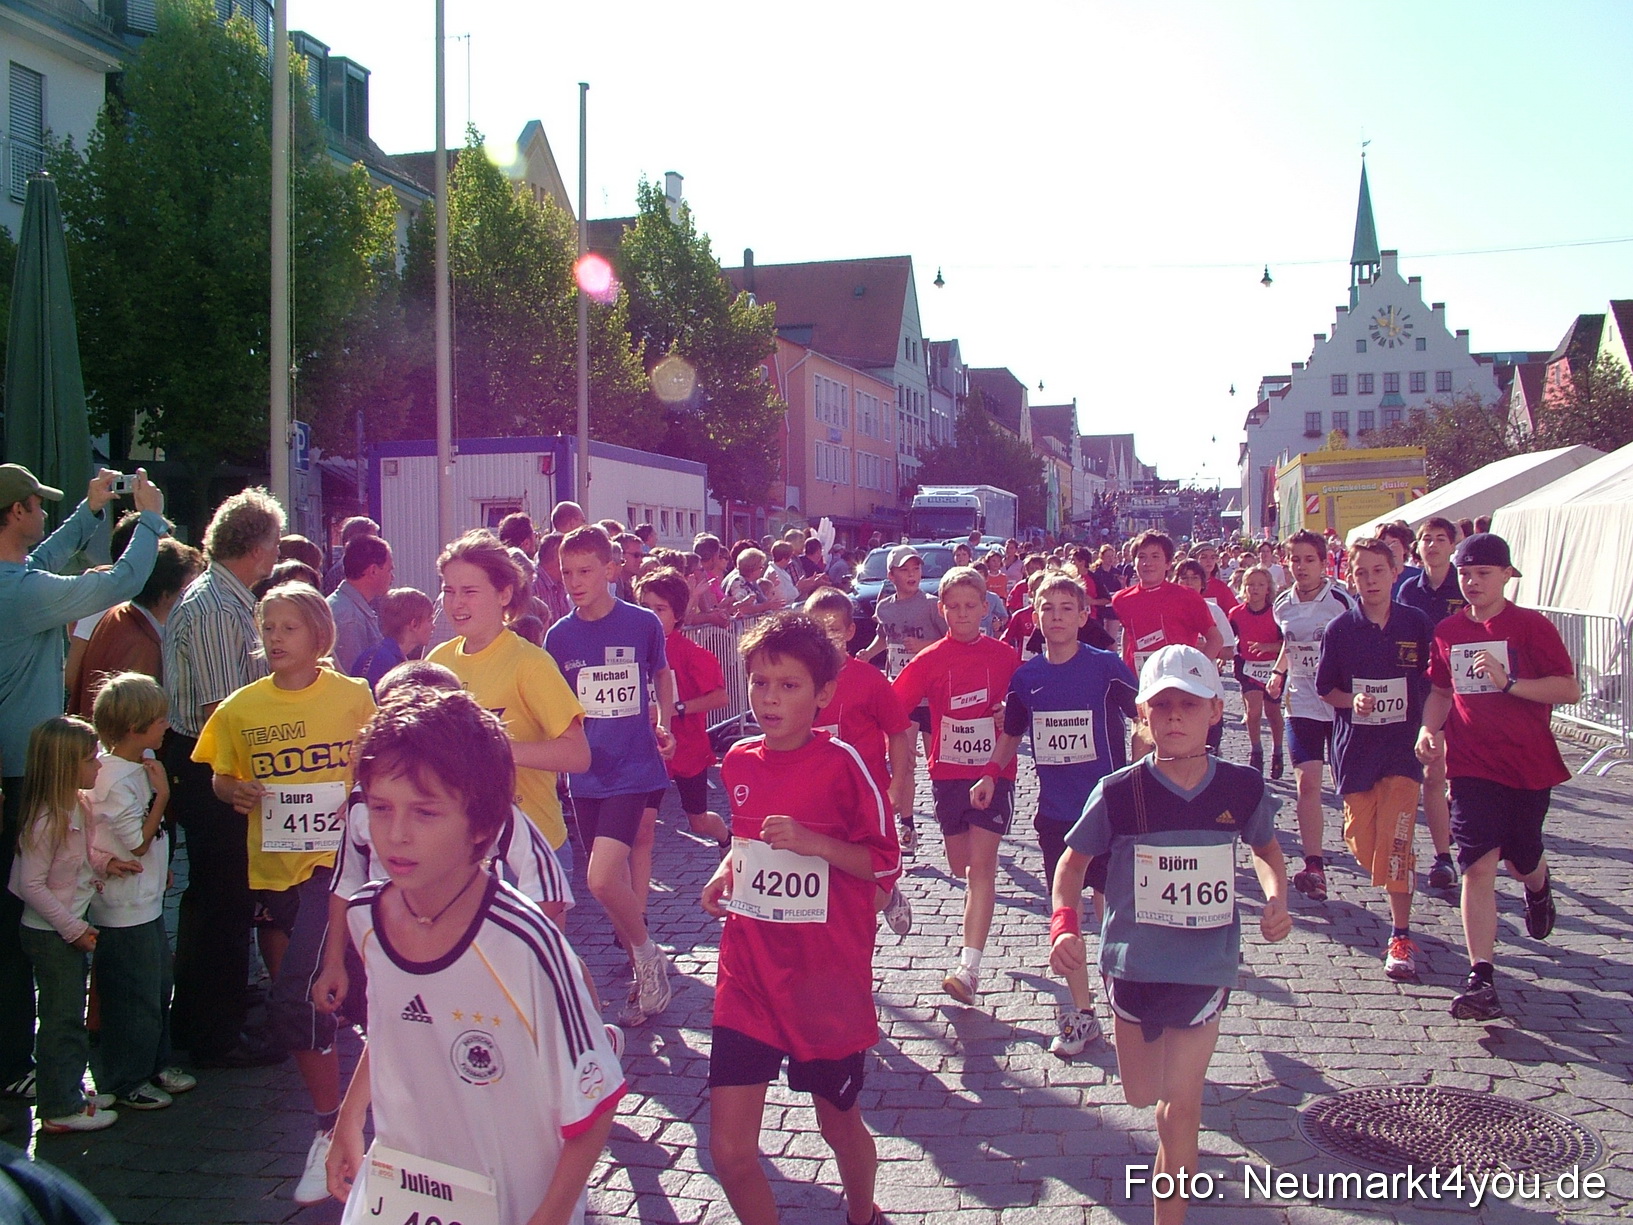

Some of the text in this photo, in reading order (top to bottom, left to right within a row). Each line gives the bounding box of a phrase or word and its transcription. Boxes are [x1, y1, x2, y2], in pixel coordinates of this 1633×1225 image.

[297, 428, 306, 462] P
[1454, 663, 1459, 672] J
[592, 670, 629, 682] Michael
[581, 687, 587, 696] J
[595, 685, 636, 703] 4167
[1365, 684, 1388, 694] David
[1371, 697, 1405, 714] 070
[951, 724, 976, 735] Lukas
[1045, 716, 1090, 728] Alexander
[242, 721, 306, 746] TEAM
[1036, 731, 1042, 741] J
[953, 738, 993, 754] 4048
[1048, 734, 1088, 750] 4071
[252, 740, 353, 779] BOCK
[279, 791, 314, 805] Laura
[265, 809, 273, 820] J
[283, 812, 341, 833] 4152
[736, 860, 743, 874] J
[1158, 855, 1199, 872] Björn
[751, 869, 821, 898] 4200
[1140, 875, 1148, 888] J
[1161, 880, 1229, 906] 4166
[784, 908, 826, 918] PFLEIDERER
[400, 1168, 453, 1202] Julian
[370, 1196, 384, 1216] J
